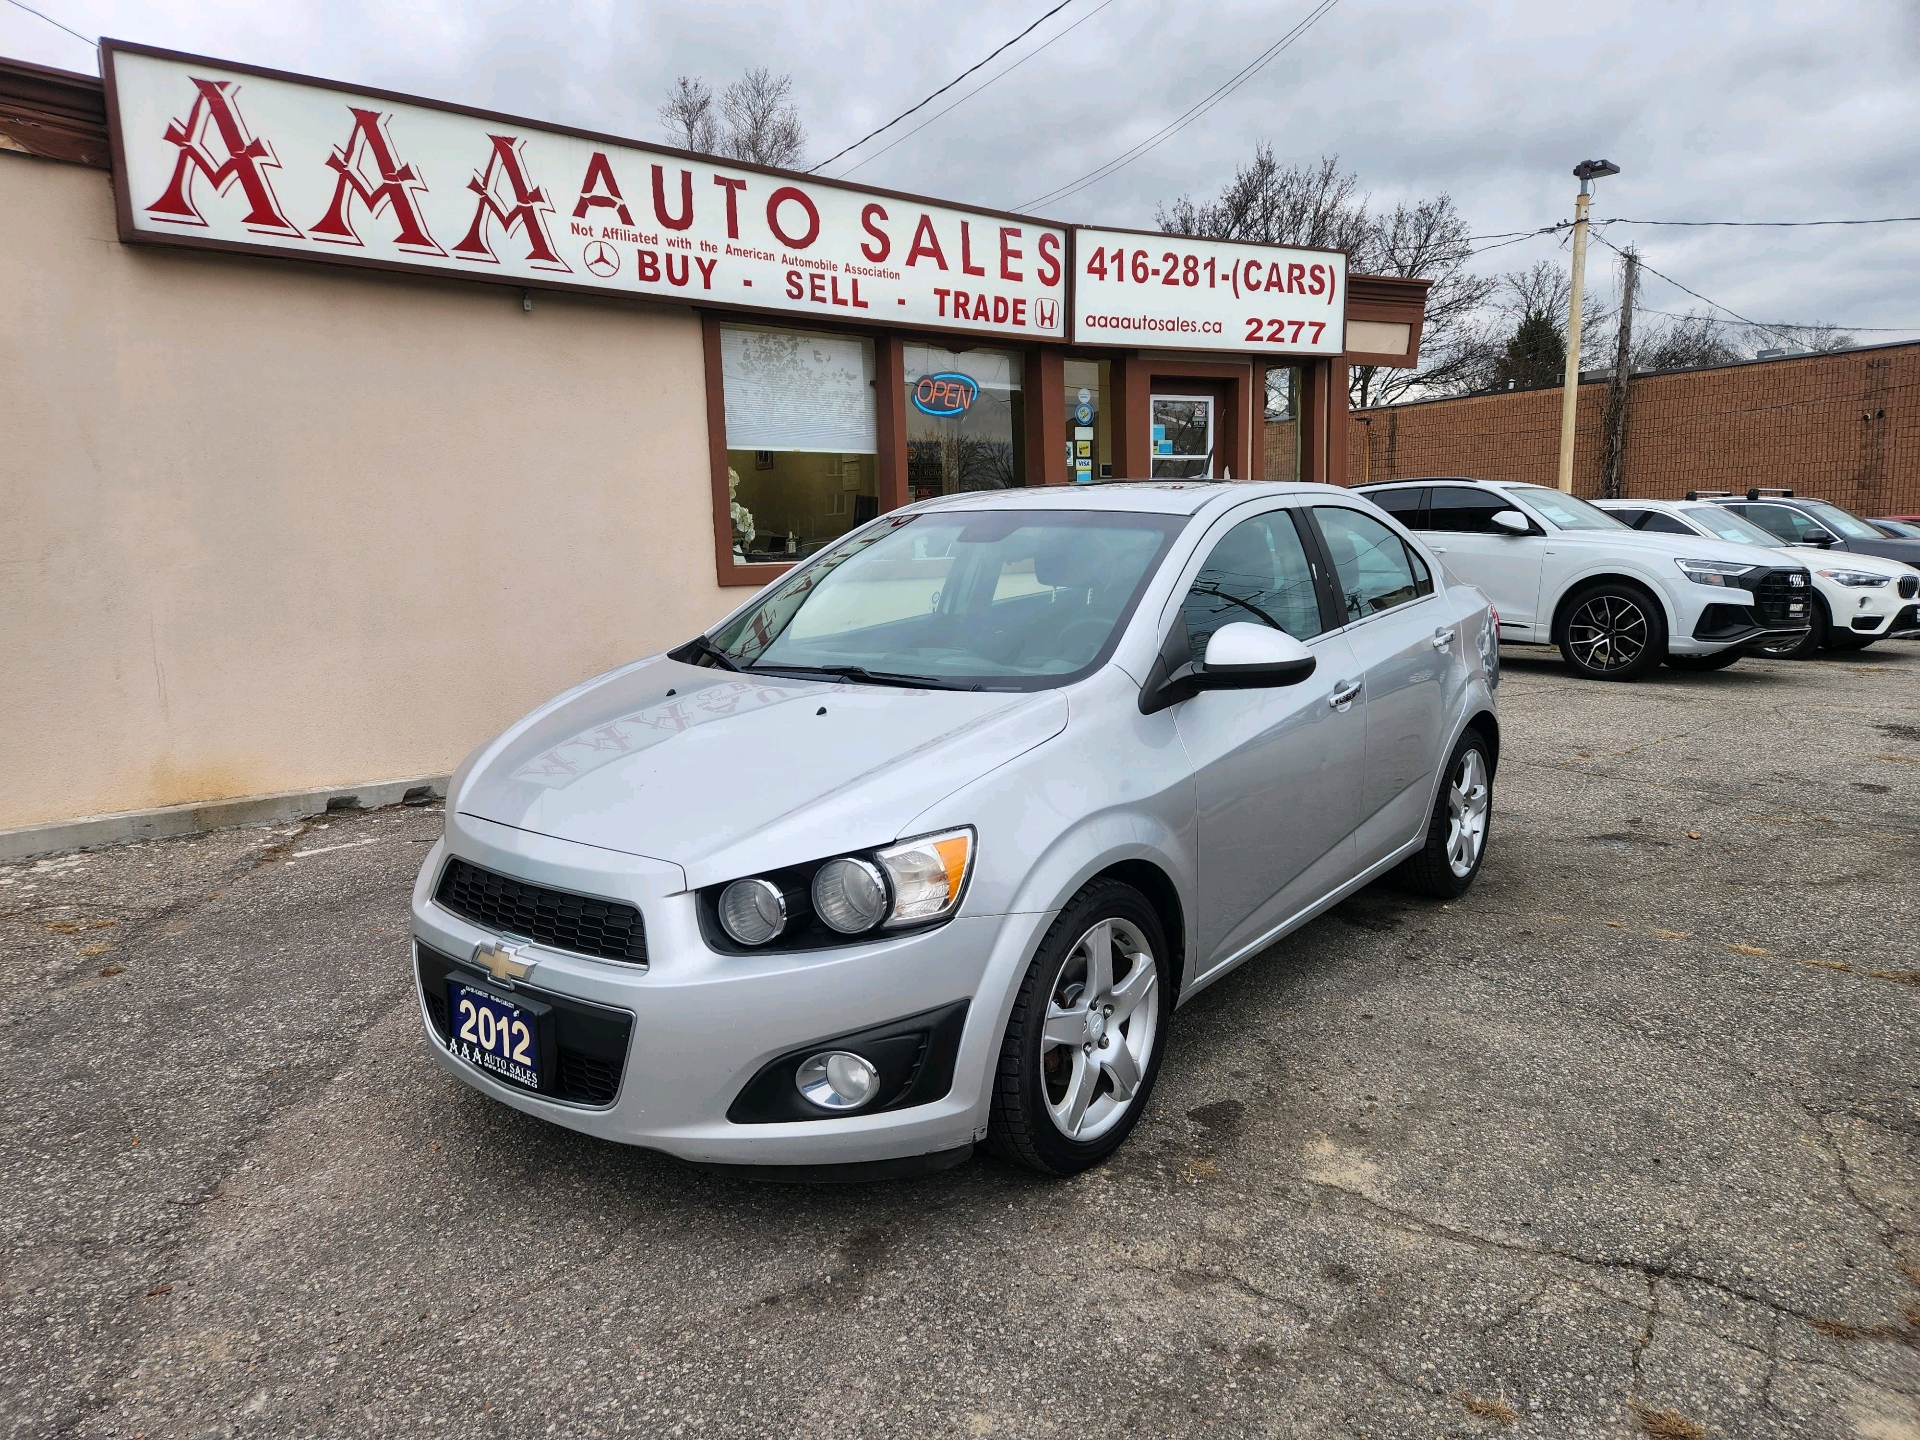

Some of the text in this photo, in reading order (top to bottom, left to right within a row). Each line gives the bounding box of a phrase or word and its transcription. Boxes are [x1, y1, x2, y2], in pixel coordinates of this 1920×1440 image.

[572, 152, 820, 250] AUTO
[860, 203, 1061, 287] SALES
[570, 222, 901, 280] Not Affiliated with the American Automobile Association
[1086, 246, 1336, 305] 416-281-(CARS)
[636, 249, 718, 290] BUY
[785, 270, 869, 309] SELL
[933, 288, 1027, 326] TRADE
[1085, 314, 1222, 334] aaaautosales.ca
[1245, 317, 1326, 344] 2277
[916, 378, 974, 409] OPEN
[459, 1000, 532, 1067] 2012
[483, 1052, 507, 1070] AUTO
[509, 1063, 538, 1083] SALES
